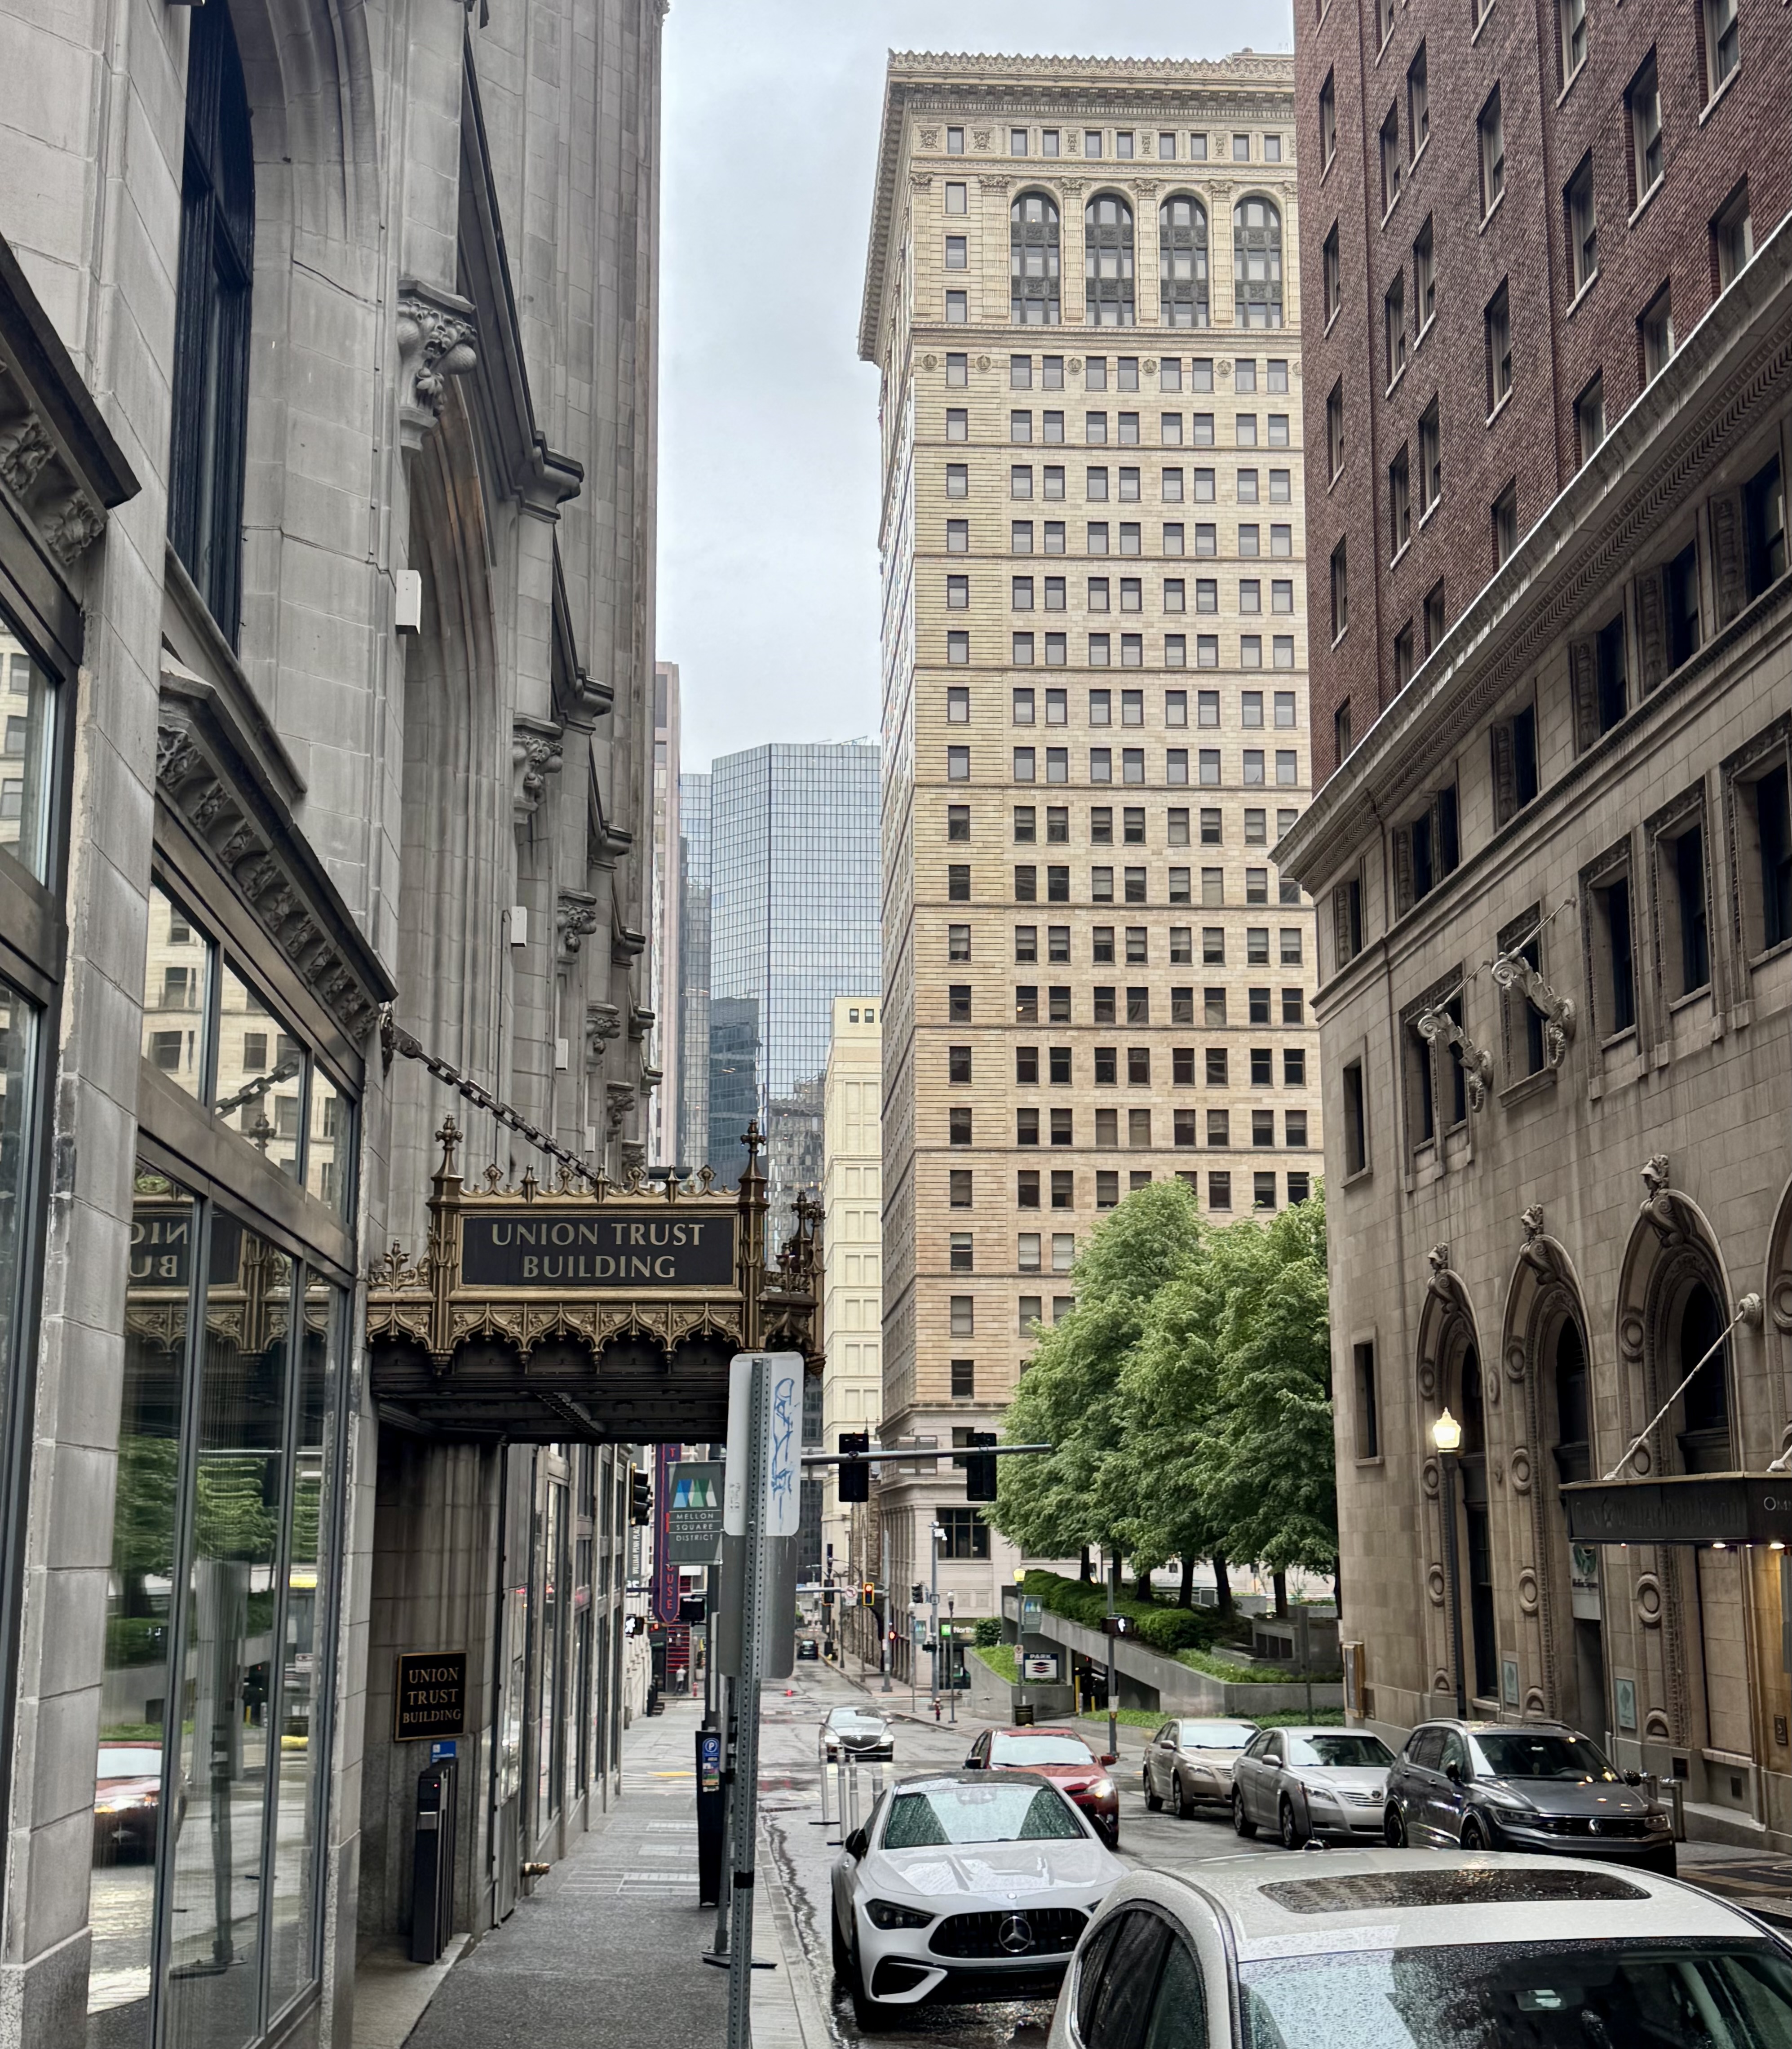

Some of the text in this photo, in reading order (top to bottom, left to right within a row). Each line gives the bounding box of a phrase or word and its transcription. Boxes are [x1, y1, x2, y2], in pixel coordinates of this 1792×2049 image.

[492, 1223, 705, 1246] UNION TRUST
[523, 1255, 676, 1277] BUILDING
[409, 1667, 459, 1684] UNION
[407, 1689, 459, 1705] TRUST
[403, 1709, 461, 1723] BUILDING
